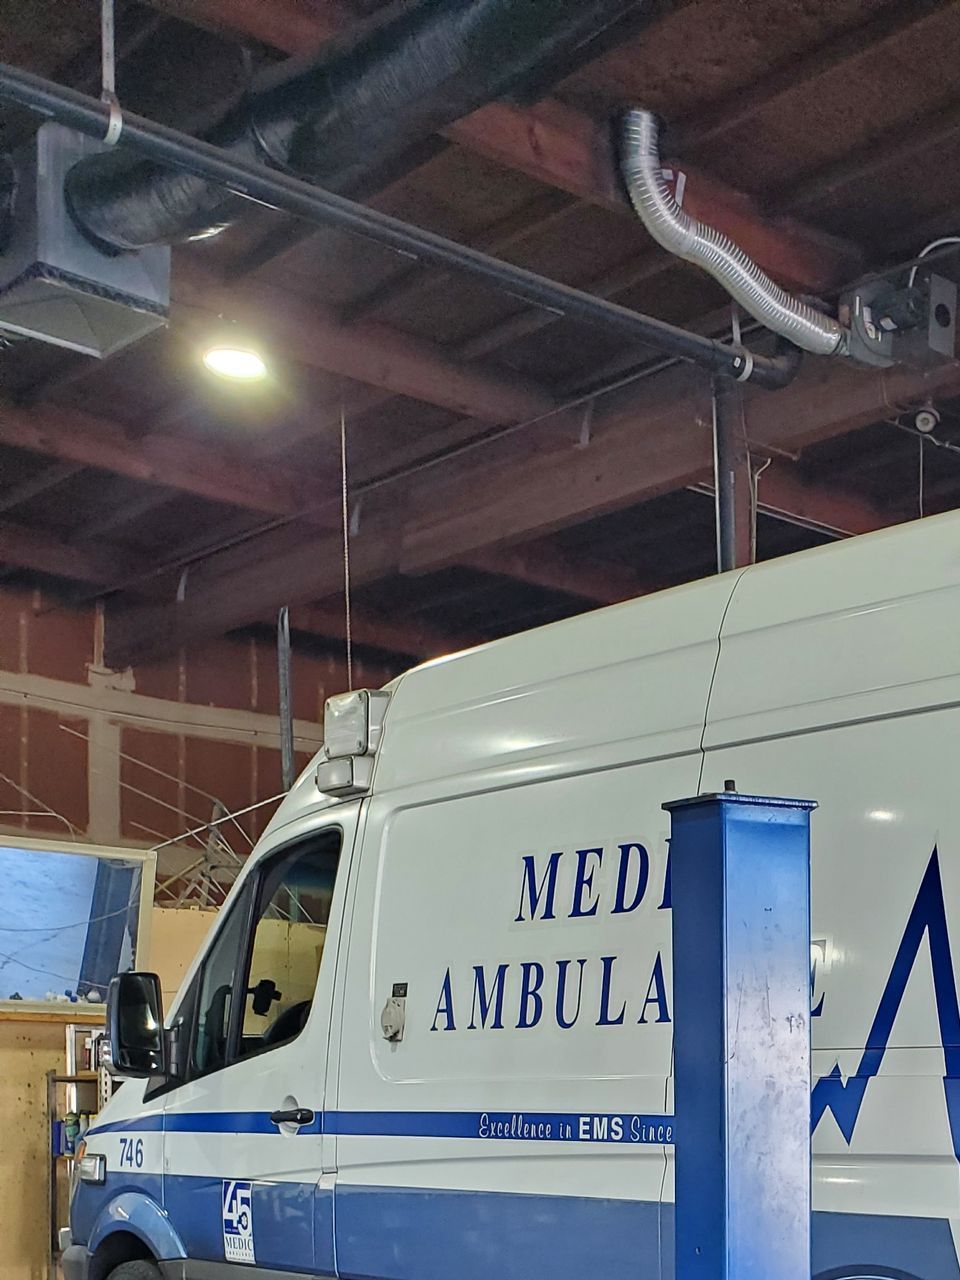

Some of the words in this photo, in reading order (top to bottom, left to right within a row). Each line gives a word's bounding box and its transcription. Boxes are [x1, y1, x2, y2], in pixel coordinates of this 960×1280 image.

[514, 836, 672, 922] MEDI
[430, 939, 825, 1032] AMBULAE
[479, 1113, 551, 1139] Excellence
[560, 1122, 571, 1138] in
[579, 1117, 623, 1140] EMS
[631, 1116, 672, 1142] Since
[120, 1138, 143, 1167] 746
[225, 1236, 252, 1251] MEDIC
